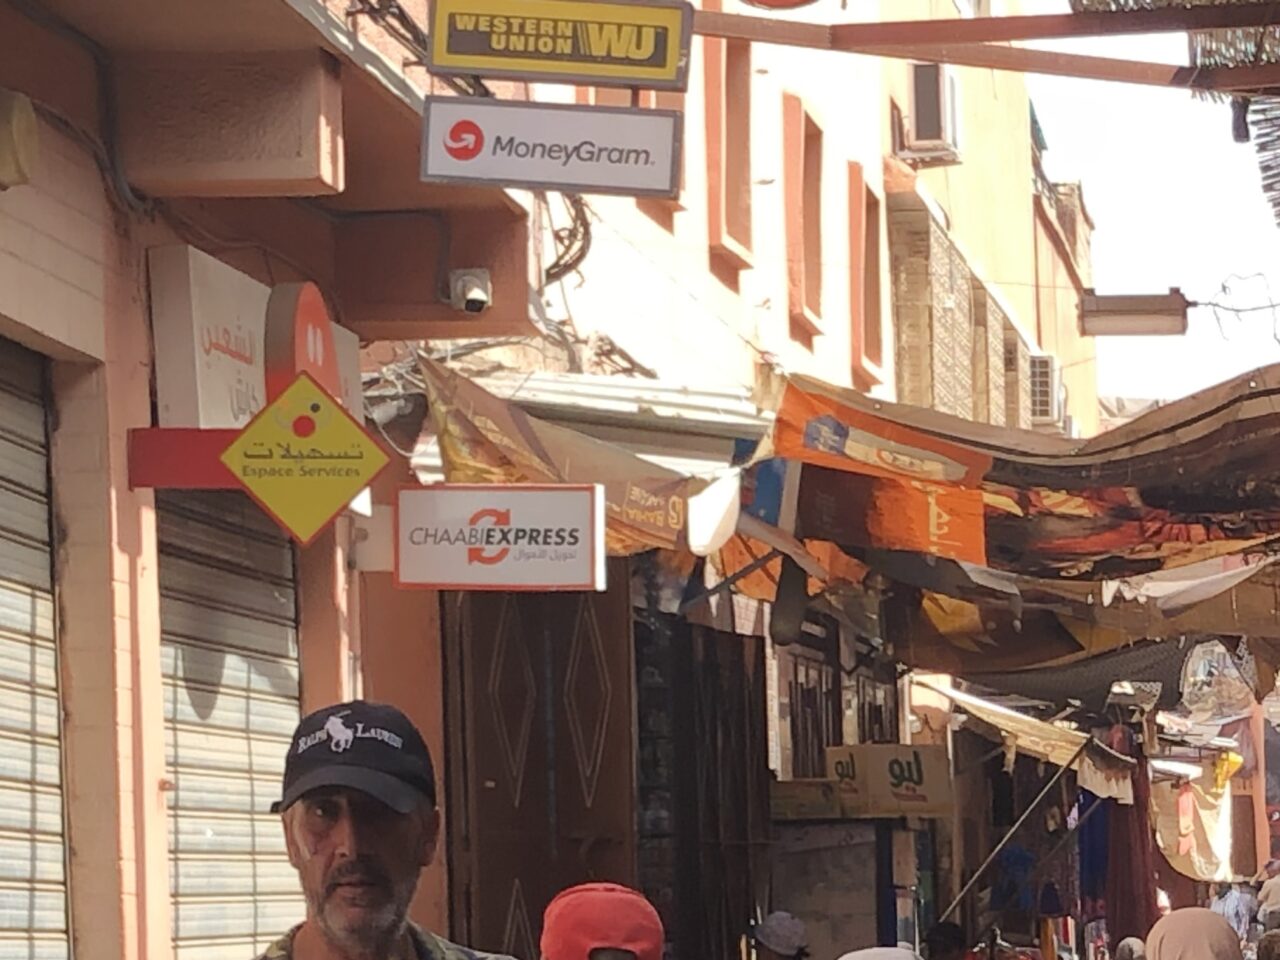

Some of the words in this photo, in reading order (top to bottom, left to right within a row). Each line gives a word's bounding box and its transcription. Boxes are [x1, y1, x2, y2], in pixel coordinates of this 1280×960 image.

[454, 14, 573, 36] WESTERN
[490, 35, 572, 54] UNION
[587, 23, 656, 60] WU
[243, 442, 364, 461] تسهيلات
[242, 465, 294, 478] Espace
[299, 465, 360, 477] Services
